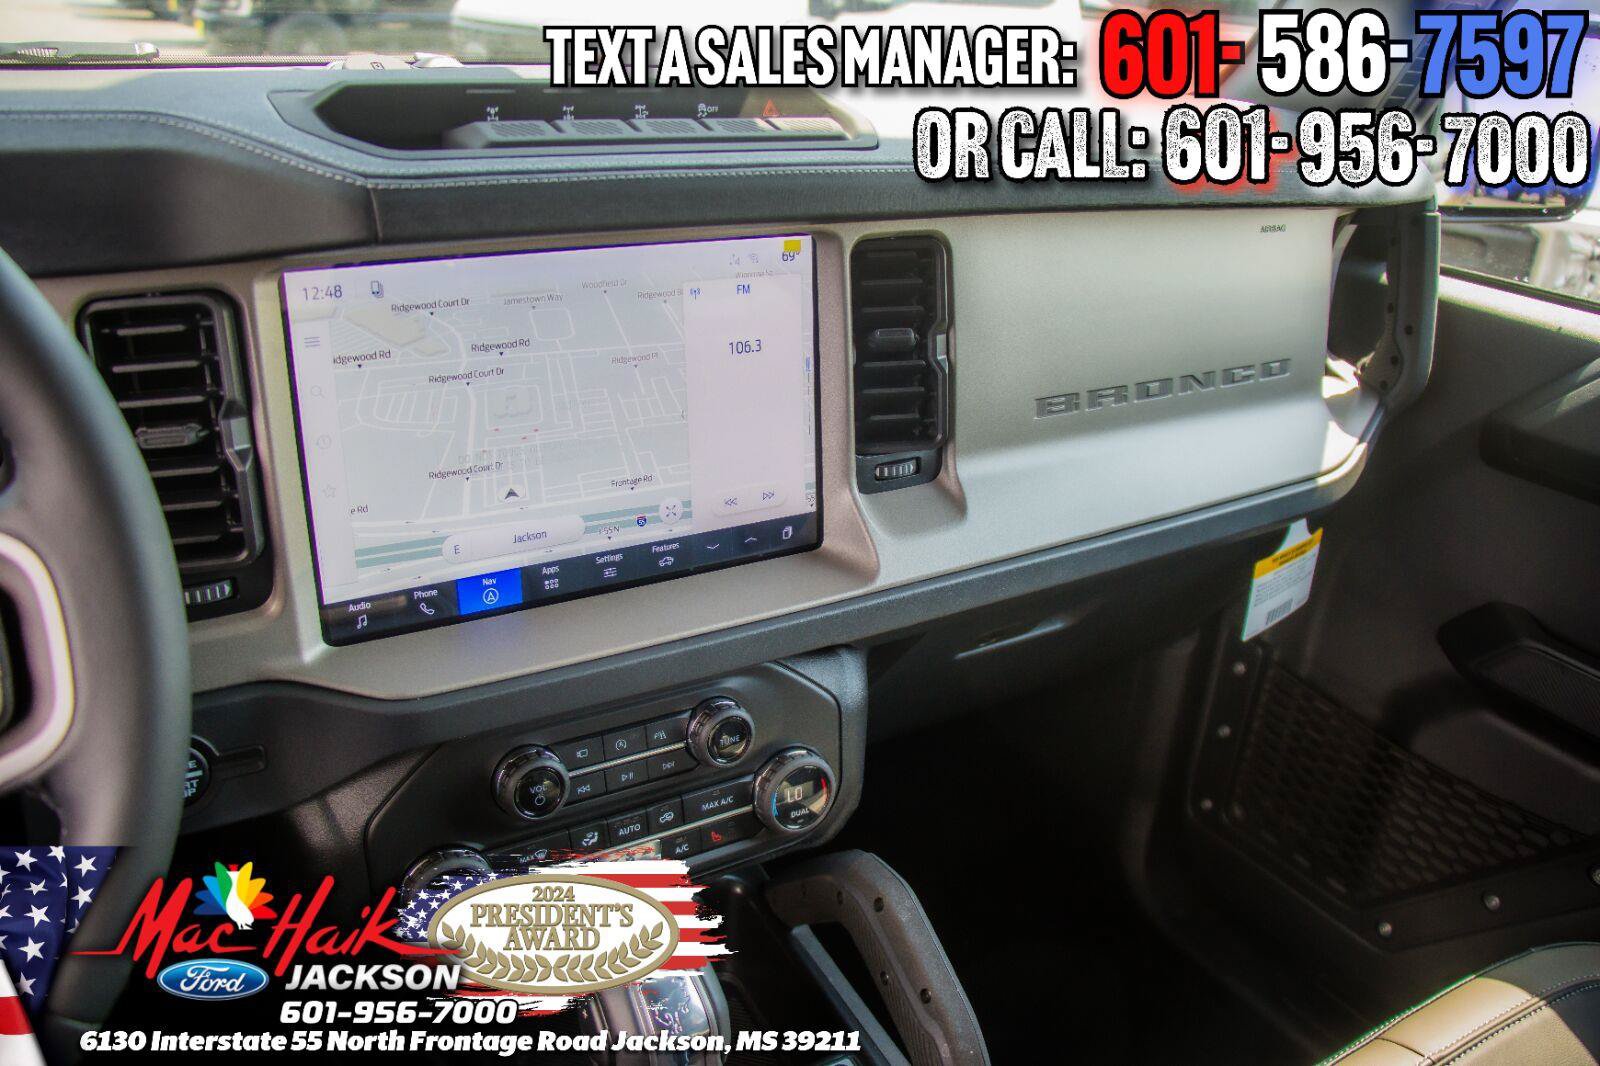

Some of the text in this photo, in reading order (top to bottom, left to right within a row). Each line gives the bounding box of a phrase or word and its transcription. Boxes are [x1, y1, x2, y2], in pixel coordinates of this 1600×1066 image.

[302, 284, 343, 301] 12:48
[637, 289, 675, 300] Ridgewood
[736, 284, 751, 295] FM
[391, 297, 470, 313] Ridgewood Court Dr
[503, 293, 564, 306] Jamestown Way
[471, 338, 531, 353] Ridgewood Rd
[728, 339, 762, 356] 106.3
[333, 350, 392, 365] idgewood Rd
[611, 353, 651, 365] Ridgewood
[428, 367, 505, 384] Ridgewood Court Dr
[1033, 358, 1291, 420] BRONCO
[428, 461, 504, 480] Ridgewood Court Dr
[610, 473, 654, 488] Frontage Rd
[357, 504, 369, 514] Rd
[513, 530, 548, 544] Jackson
[454, 545, 461, 555] E
[652, 542, 680, 553] Features
[595, 552, 623, 565] Settings
[541, 564, 560, 576] Apps
[482, 576, 498, 586] Nav
[413, 588, 438, 600] Phone
[348, 601, 371, 613] Audio
[719, 734, 741, 746] TUNE
[529, 784, 549, 795] VOL
[785, 786, 804, 803] LO
[702, 795, 734, 811] MAX A/C
[790, 807, 810, 819] DUAL
[618, 823, 641, 836] AUTO
[675, 843, 690, 855] A/C
